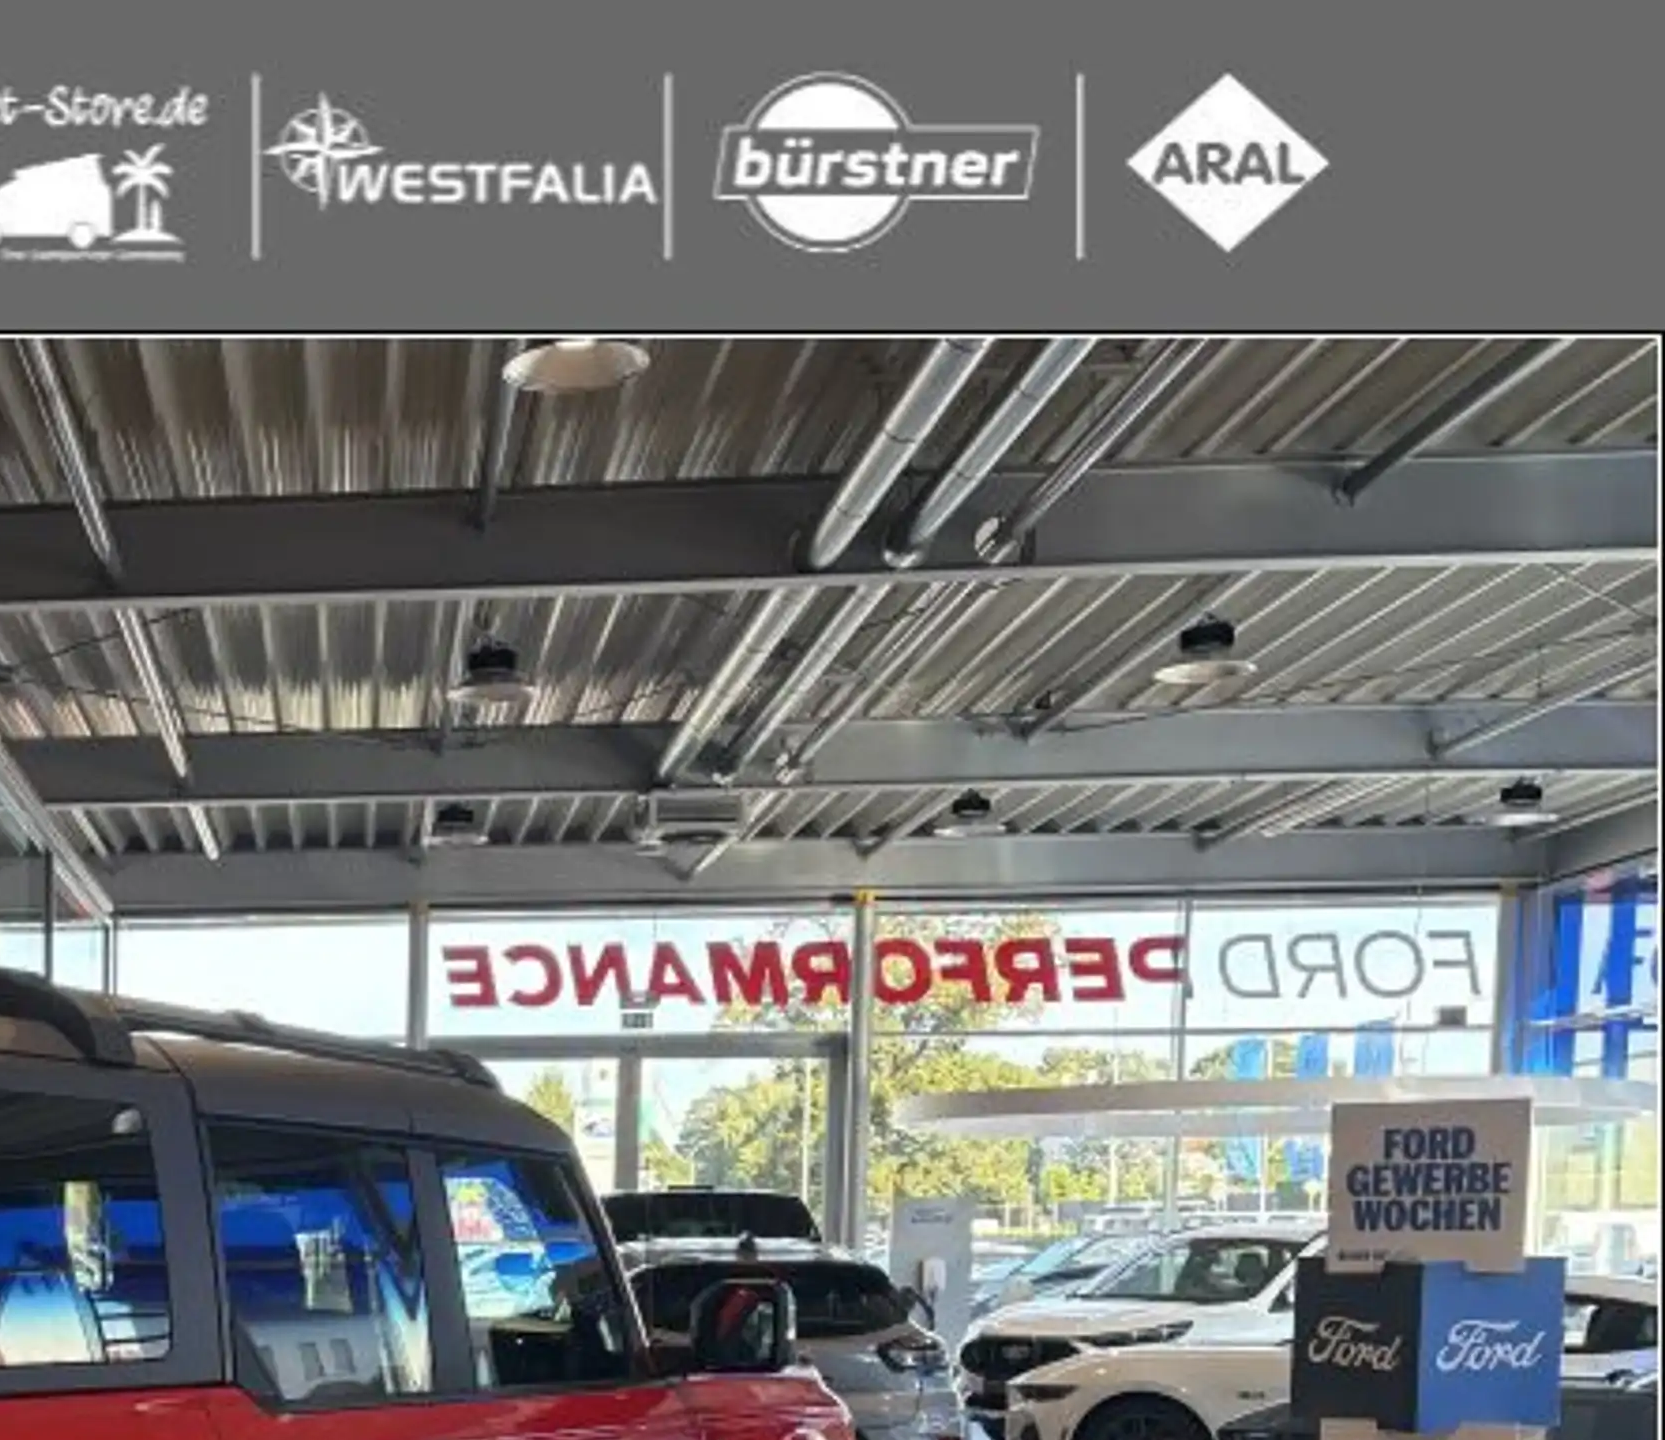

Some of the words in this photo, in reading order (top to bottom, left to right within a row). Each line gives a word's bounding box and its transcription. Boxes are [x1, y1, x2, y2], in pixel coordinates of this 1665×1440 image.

[1383, 1127, 1476, 1161] FORD
[1346, 1162, 1512, 1197] GEWERBE
[1353, 1198, 1503, 1233] WOCHEN
[1309, 1316, 1403, 1371] Ford
[1436, 1319, 1547, 1371] Ford
